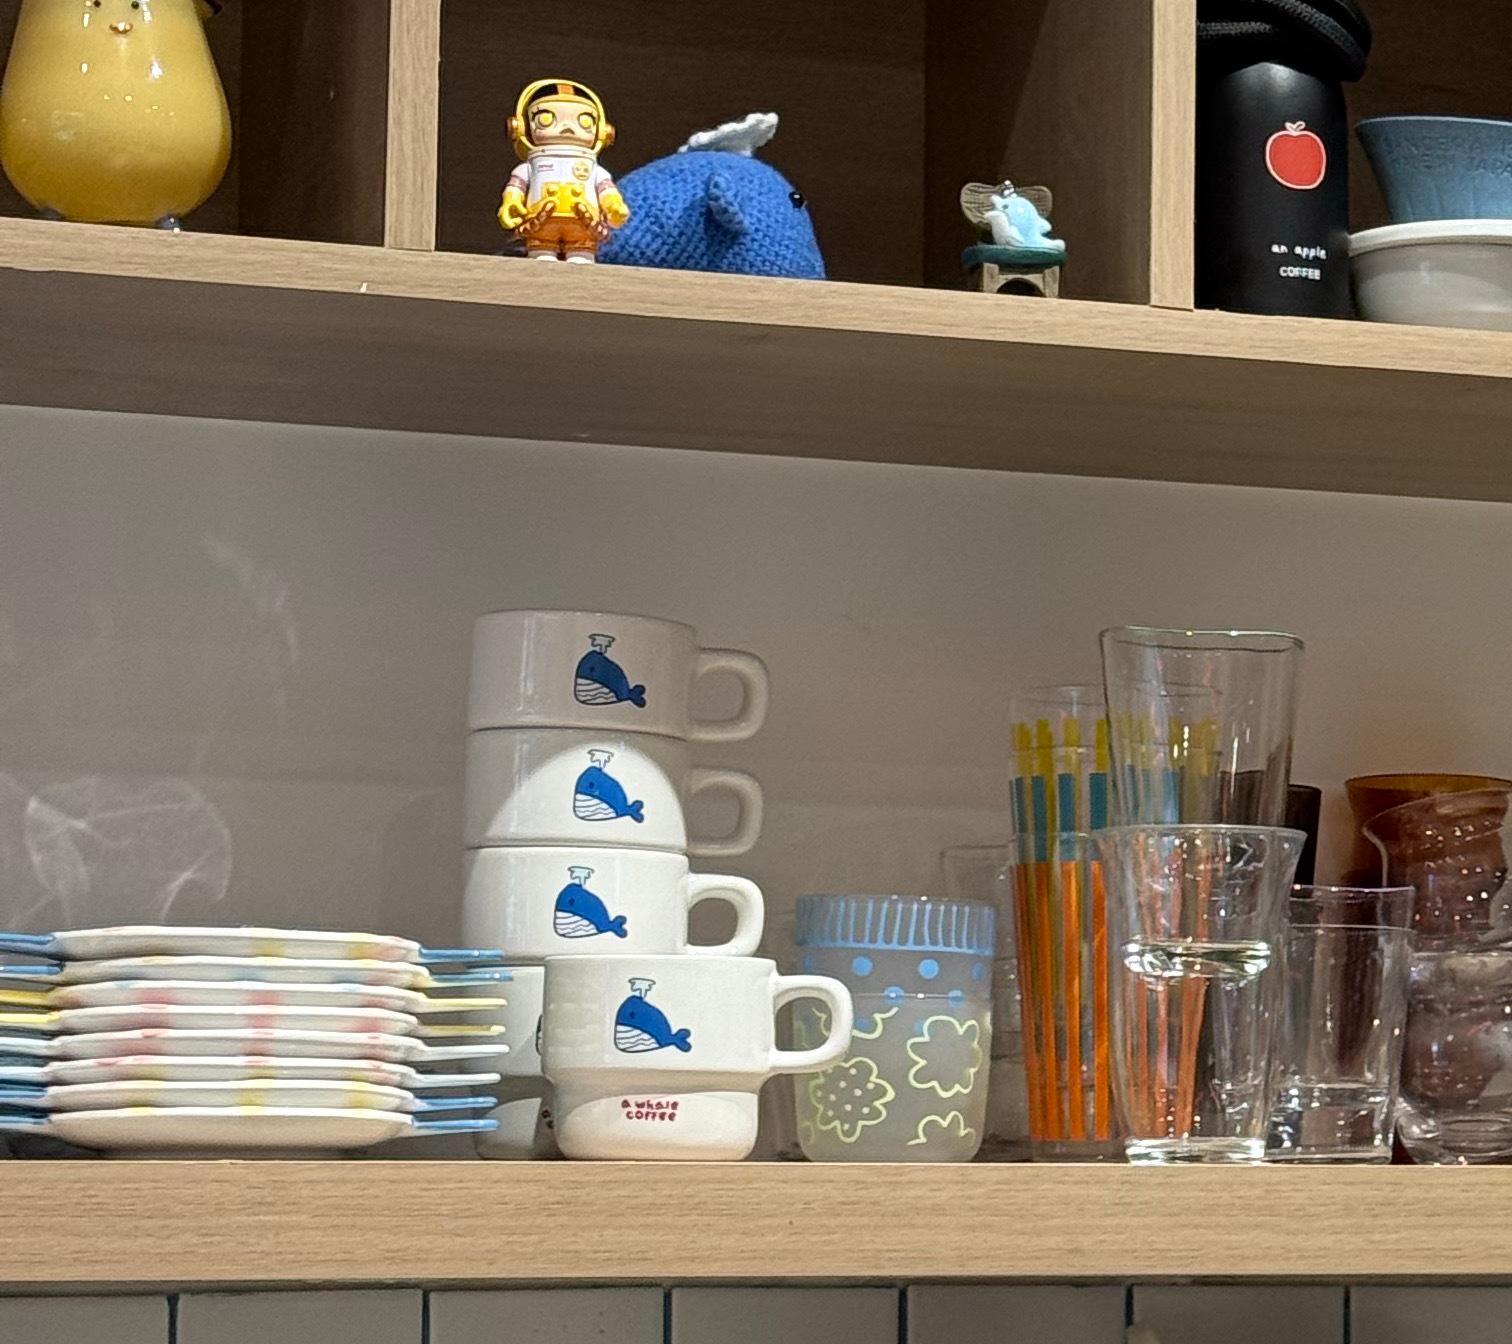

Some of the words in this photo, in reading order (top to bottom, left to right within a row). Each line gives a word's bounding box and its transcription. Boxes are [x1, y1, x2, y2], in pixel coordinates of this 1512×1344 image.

[1271, 244, 1289, 254] an
[1294, 245, 1327, 261] apple
[1279, 266, 1321, 281] COFFEE
